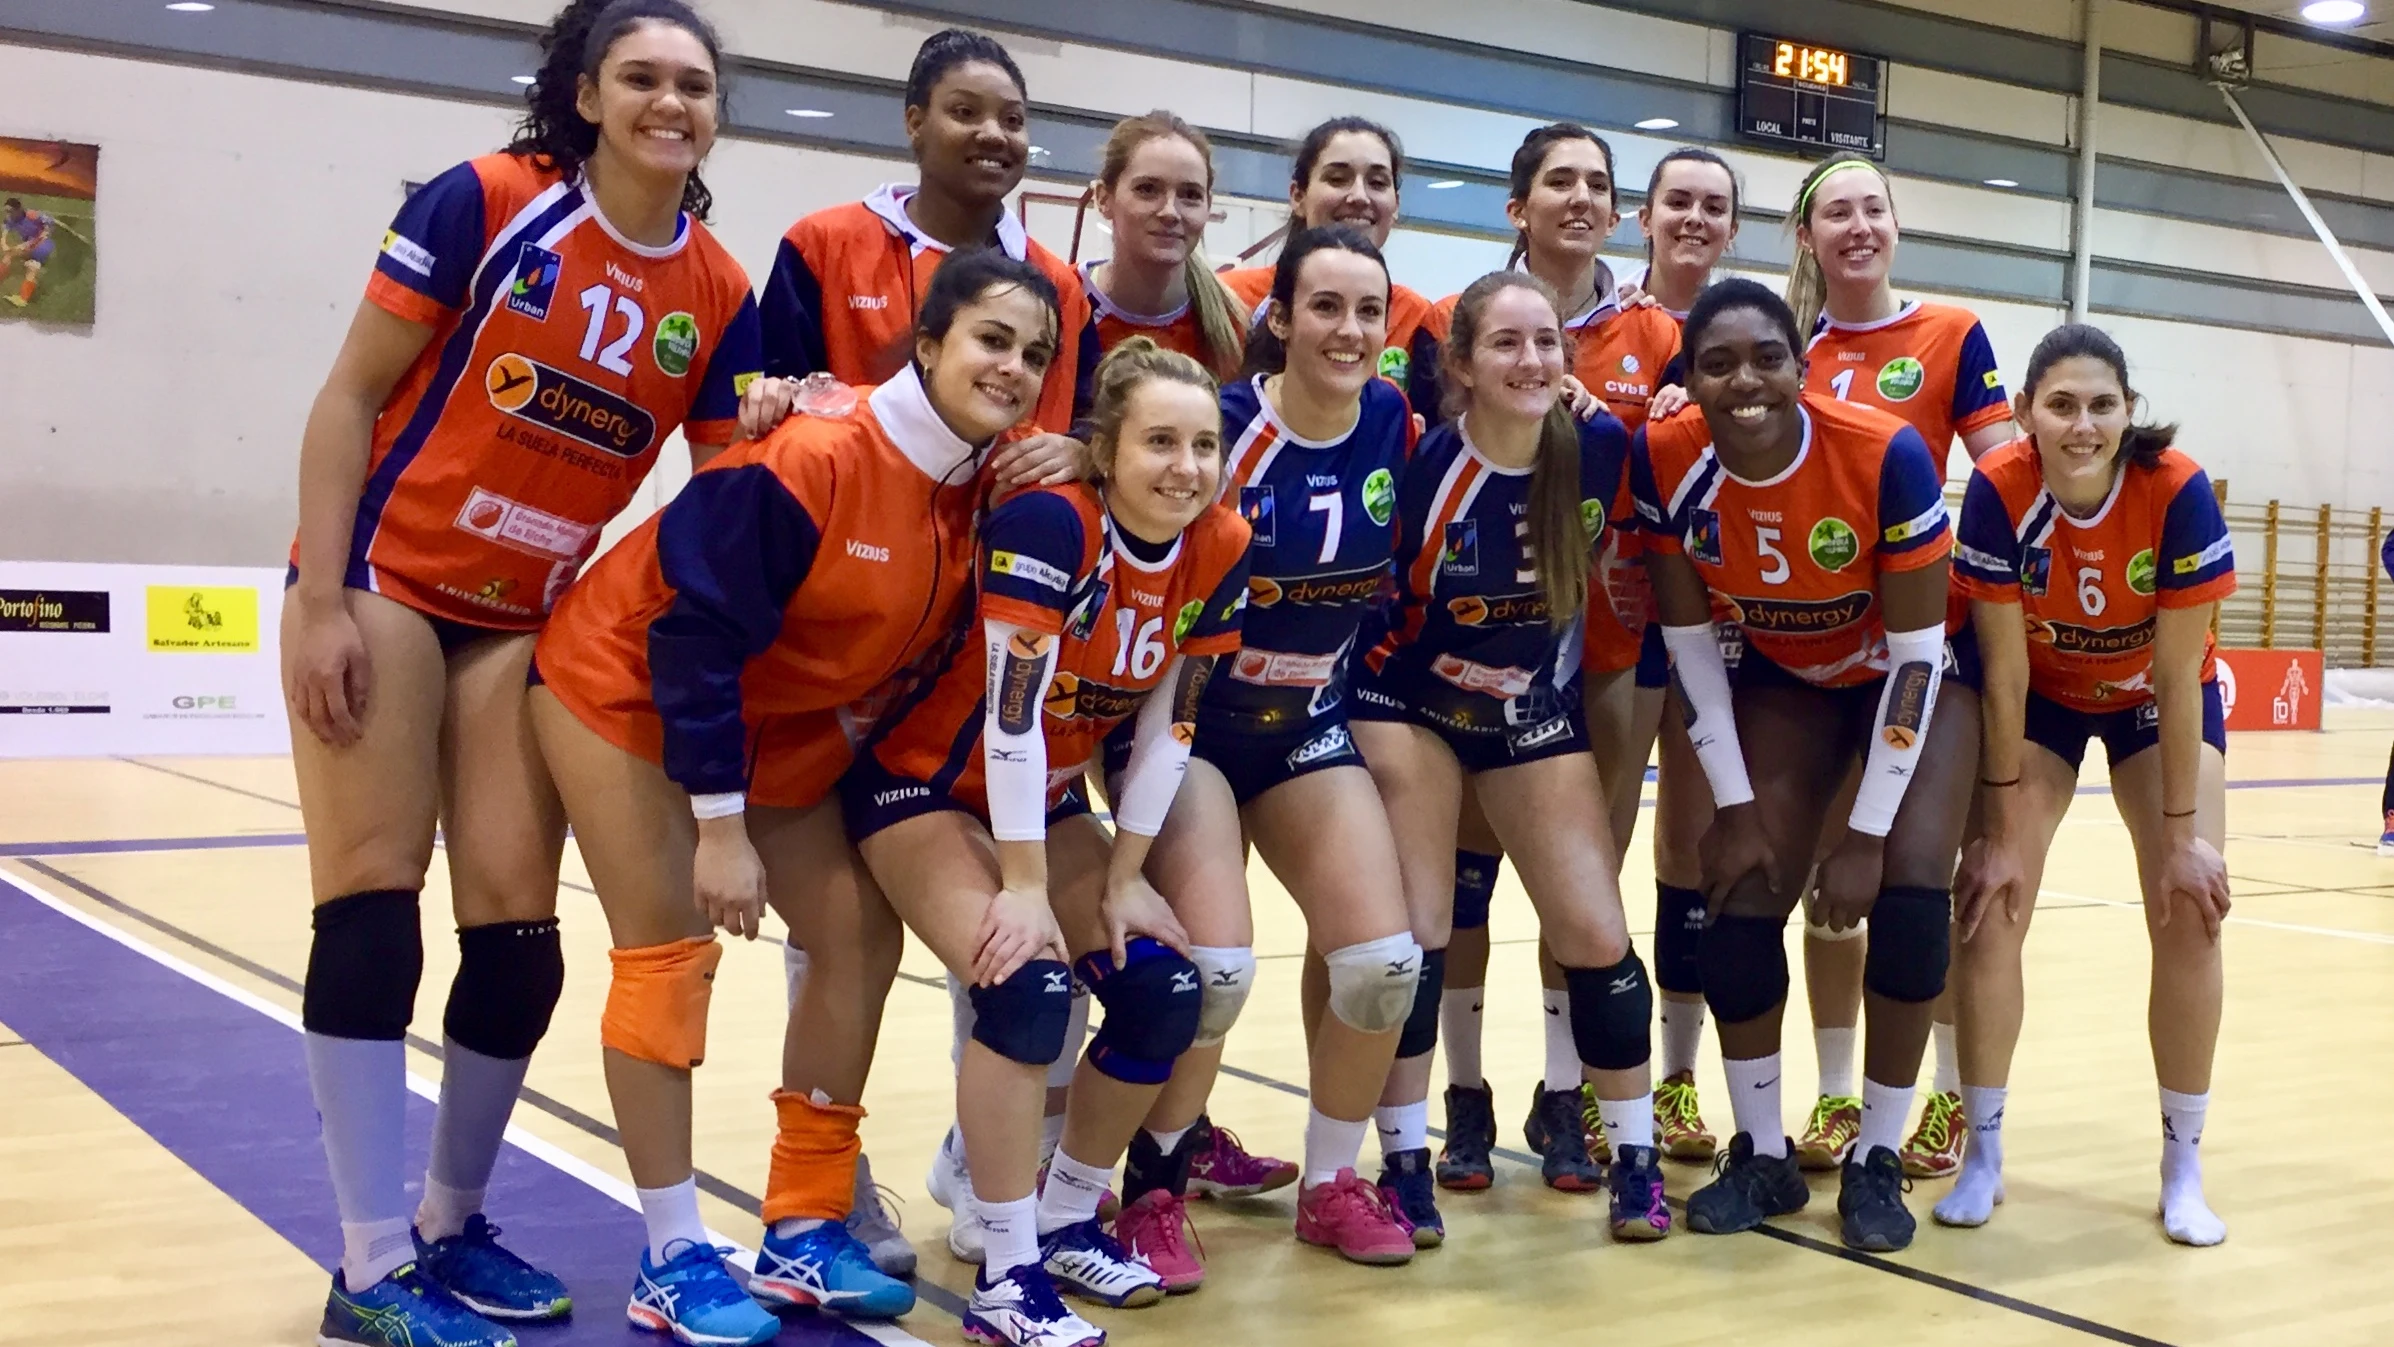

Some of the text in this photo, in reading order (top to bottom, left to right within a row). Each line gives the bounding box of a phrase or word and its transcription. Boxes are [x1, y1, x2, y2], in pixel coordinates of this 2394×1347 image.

[1775, 43, 1845, 85] 21:54
[1756, 120, 1782, 135] LOCAL
[1830, 132, 1869, 148] VISITANTE
[511, 297, 545, 318] Urban
[847, 294, 888, 310] VIZIUS
[579, 283, 644, 378] 12
[1604, 380, 1649, 396] CVbE
[1831, 368, 1855, 401] 1
[496, 422, 515, 442] LA
[1309, 491, 1343, 565] 7
[1755, 525, 1790, 584] 5
[1447, 562, 1476, 573] Urban
[2078, 567, 2107, 617] 6
[1749, 603, 1854, 628] dynergy
[1111, 607, 1166, 680] 16
[172, 696, 236, 709] GPE
[1002, 660, 1039, 724] dynergy
[874, 787, 931, 806] VIZIUS
